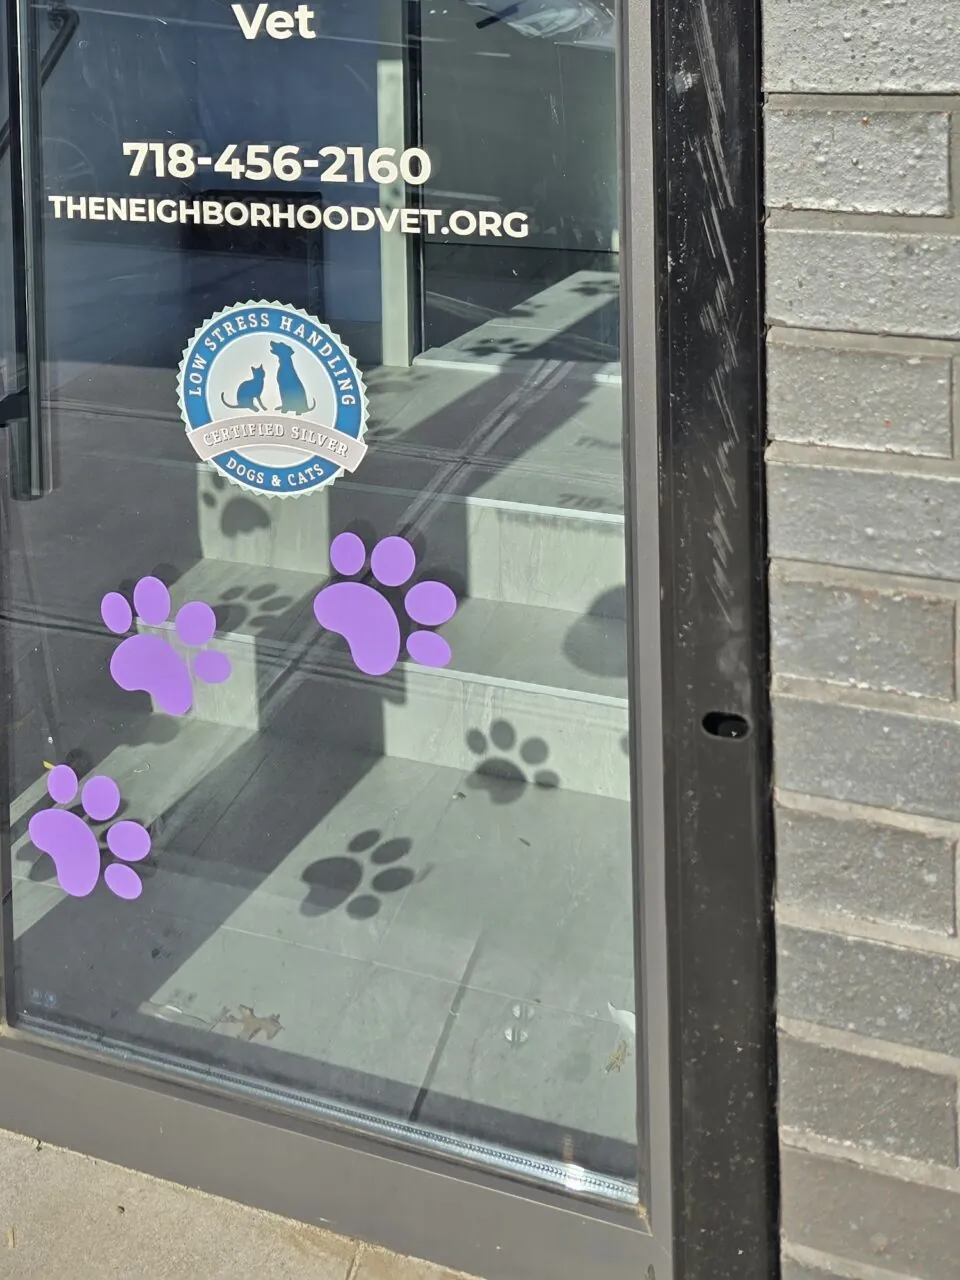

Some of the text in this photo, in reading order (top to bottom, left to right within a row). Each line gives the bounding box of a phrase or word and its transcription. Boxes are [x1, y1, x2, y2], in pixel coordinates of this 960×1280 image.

[231, 3, 317, 40] Vet
[122, 142, 432, 185] 718-456-2160
[47, 195, 529, 238] THENEIGHBORHOODVET.ORG
[189, 313, 356, 406] LOW STRESS HANDLING
[203, 423, 349, 458] CERTIFIED SILVER
[226, 457, 325, 487] DOGS & CATS
